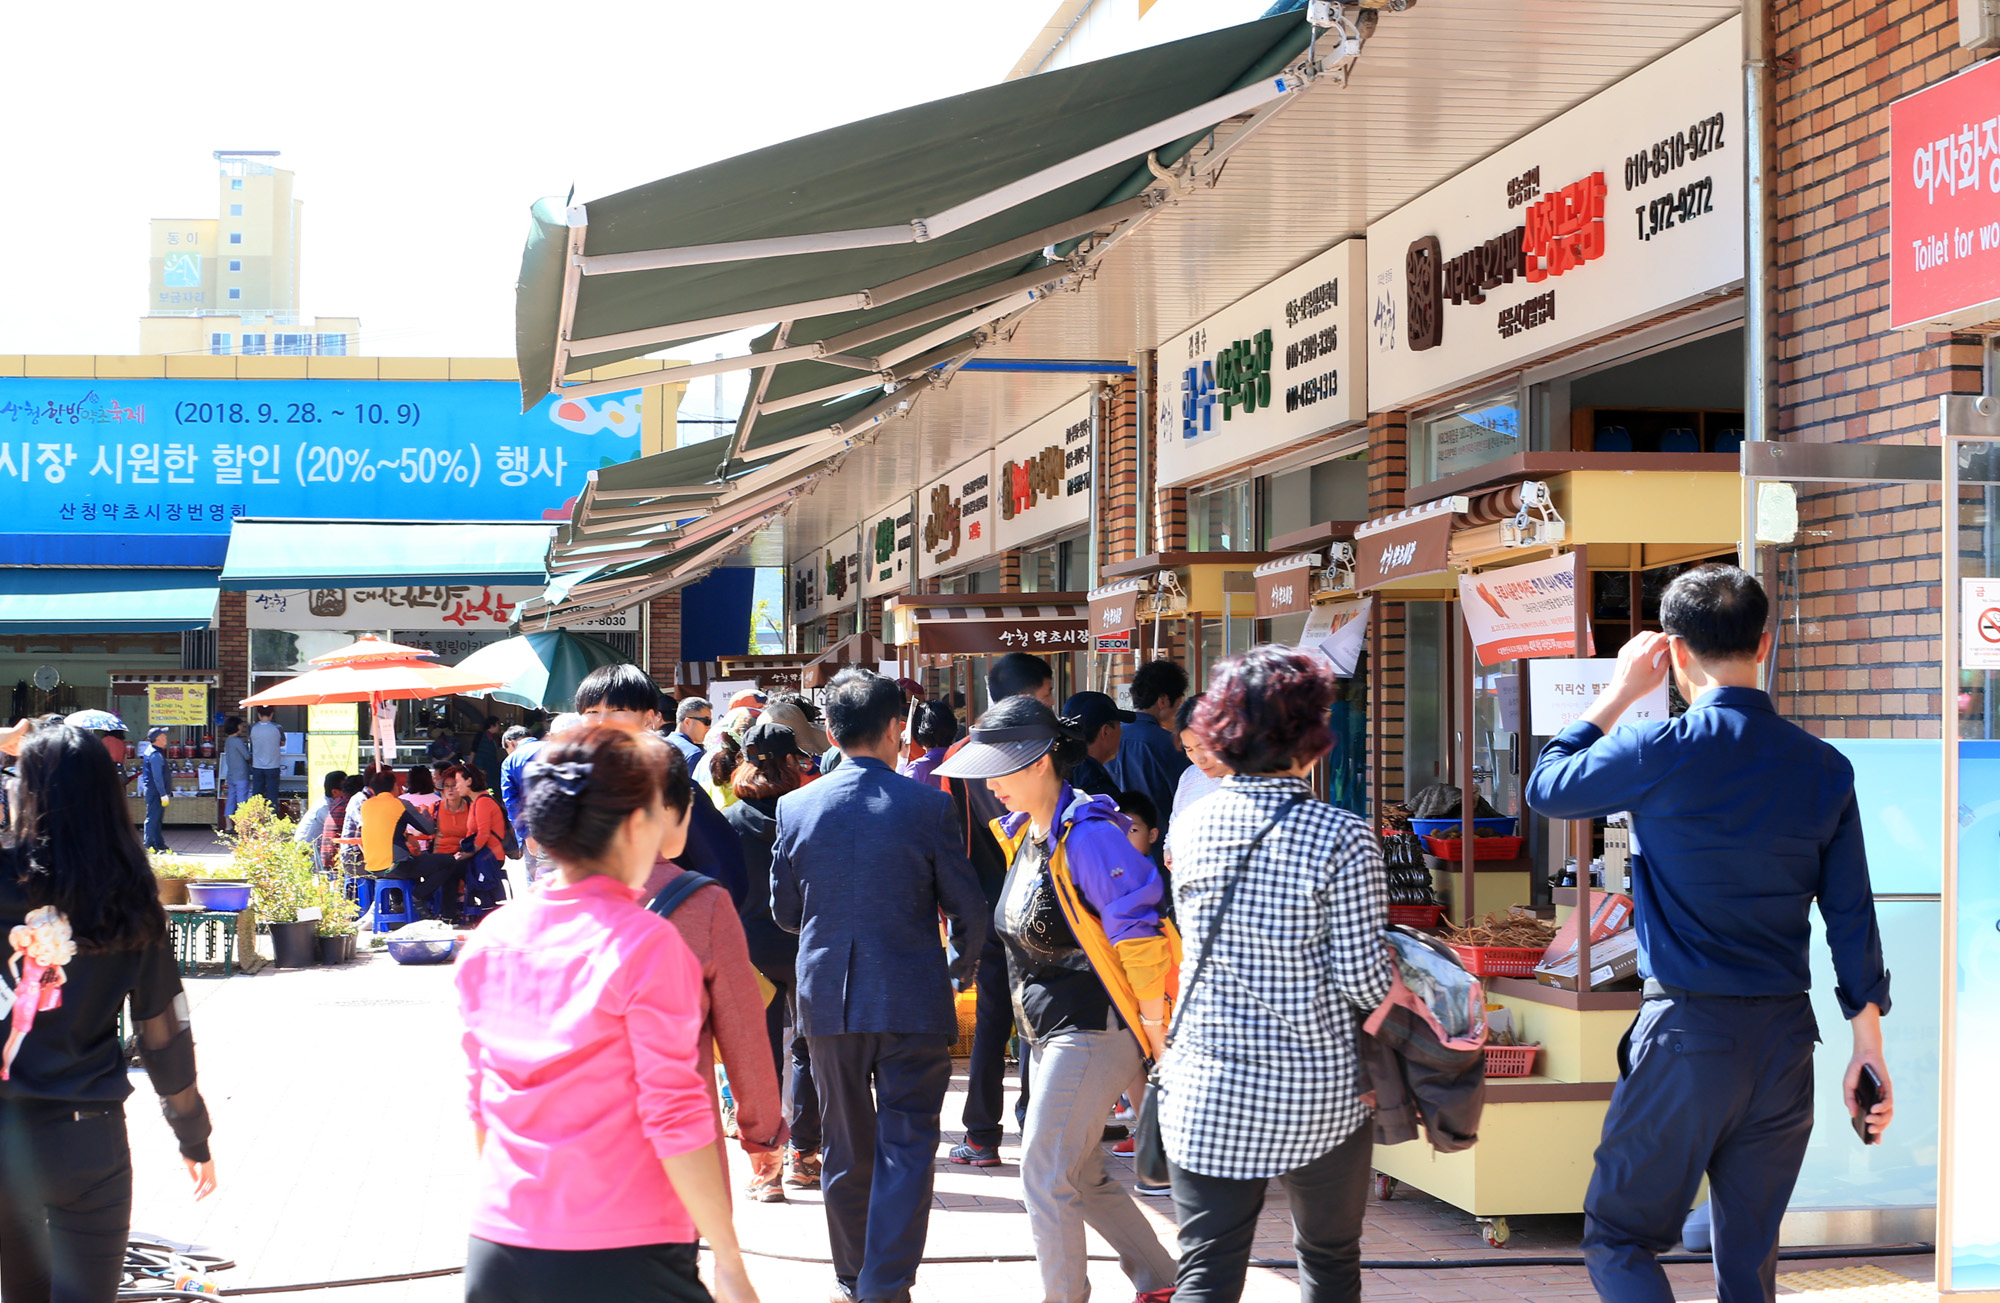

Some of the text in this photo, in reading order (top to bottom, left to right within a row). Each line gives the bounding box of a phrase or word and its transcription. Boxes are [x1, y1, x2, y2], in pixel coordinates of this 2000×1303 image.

[1624, 111, 1725, 191] 010-8510-9272
[1635, 175, 1713, 241] T.972-9272
[1913, 233, 1949, 272] Toilet
[1954, 227, 1974, 258] for
[175, 401, 249, 425] (2018.
[258, 403, 279, 424] 9.
[286, 403, 322, 423] 28.
[355, 403, 389, 424] 10.
[397, 403, 420, 427] 9)
[89, 443, 198, 484] 시원한
[212, 444, 280, 484] 할인
[296, 442, 481, 487] (20%~50%)
[496, 446, 567, 486] 행사
[999, 628, 1089, 647] 산청 약초시장
[1099, 640, 1128, 648] SECOM
[1555, 684, 1585, 695] 지리산
